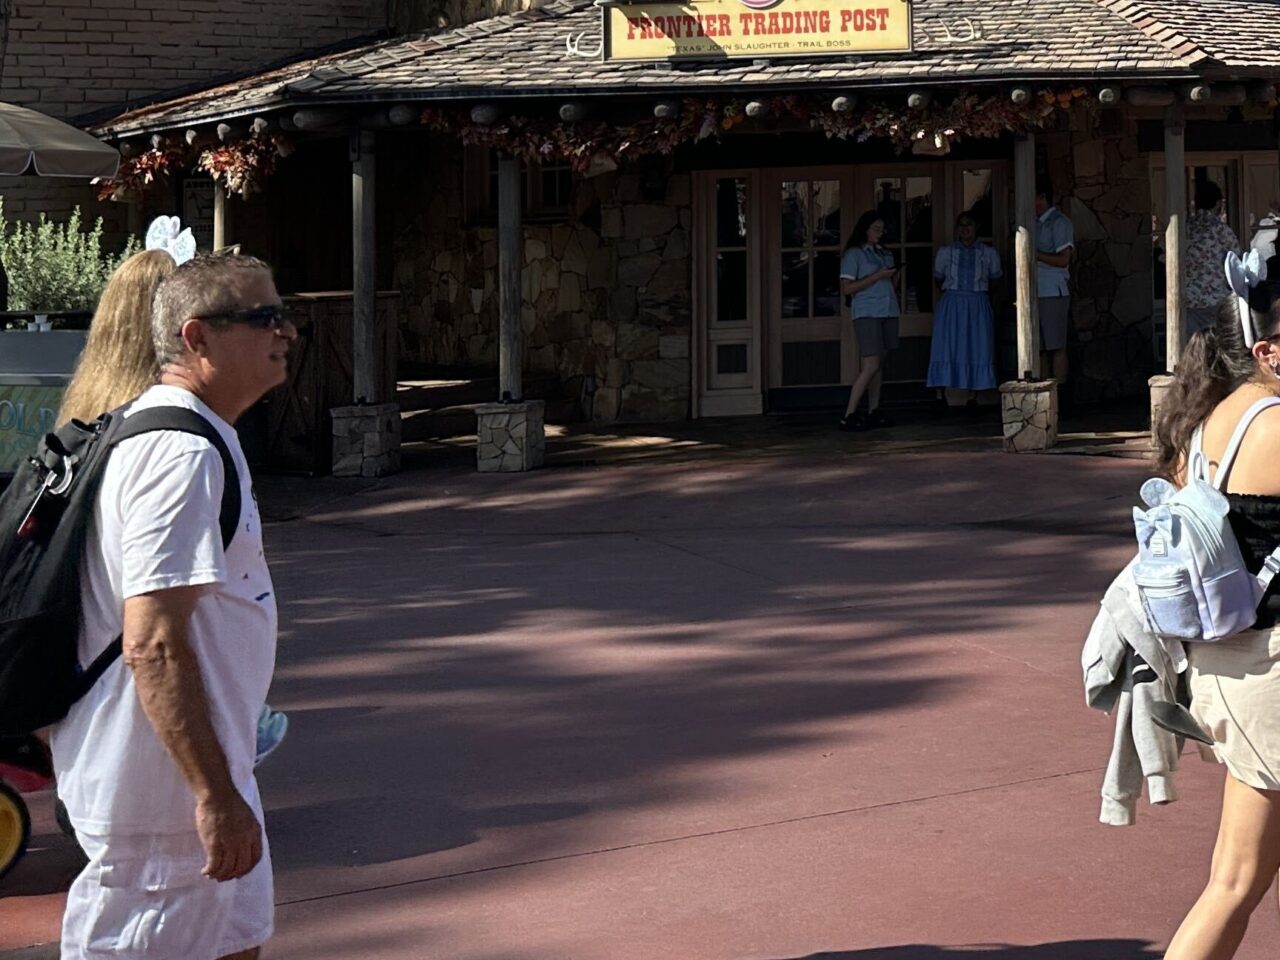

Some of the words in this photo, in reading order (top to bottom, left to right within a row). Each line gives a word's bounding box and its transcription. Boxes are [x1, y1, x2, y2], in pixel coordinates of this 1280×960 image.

[627, 14, 732, 40] FRONTIER
[739, 10, 831, 36] TRADING
[840, 8, 890, 32] POST
[707, 43, 732, 52] JOHN
[734, 41, 790, 51] SLAUGHTER
